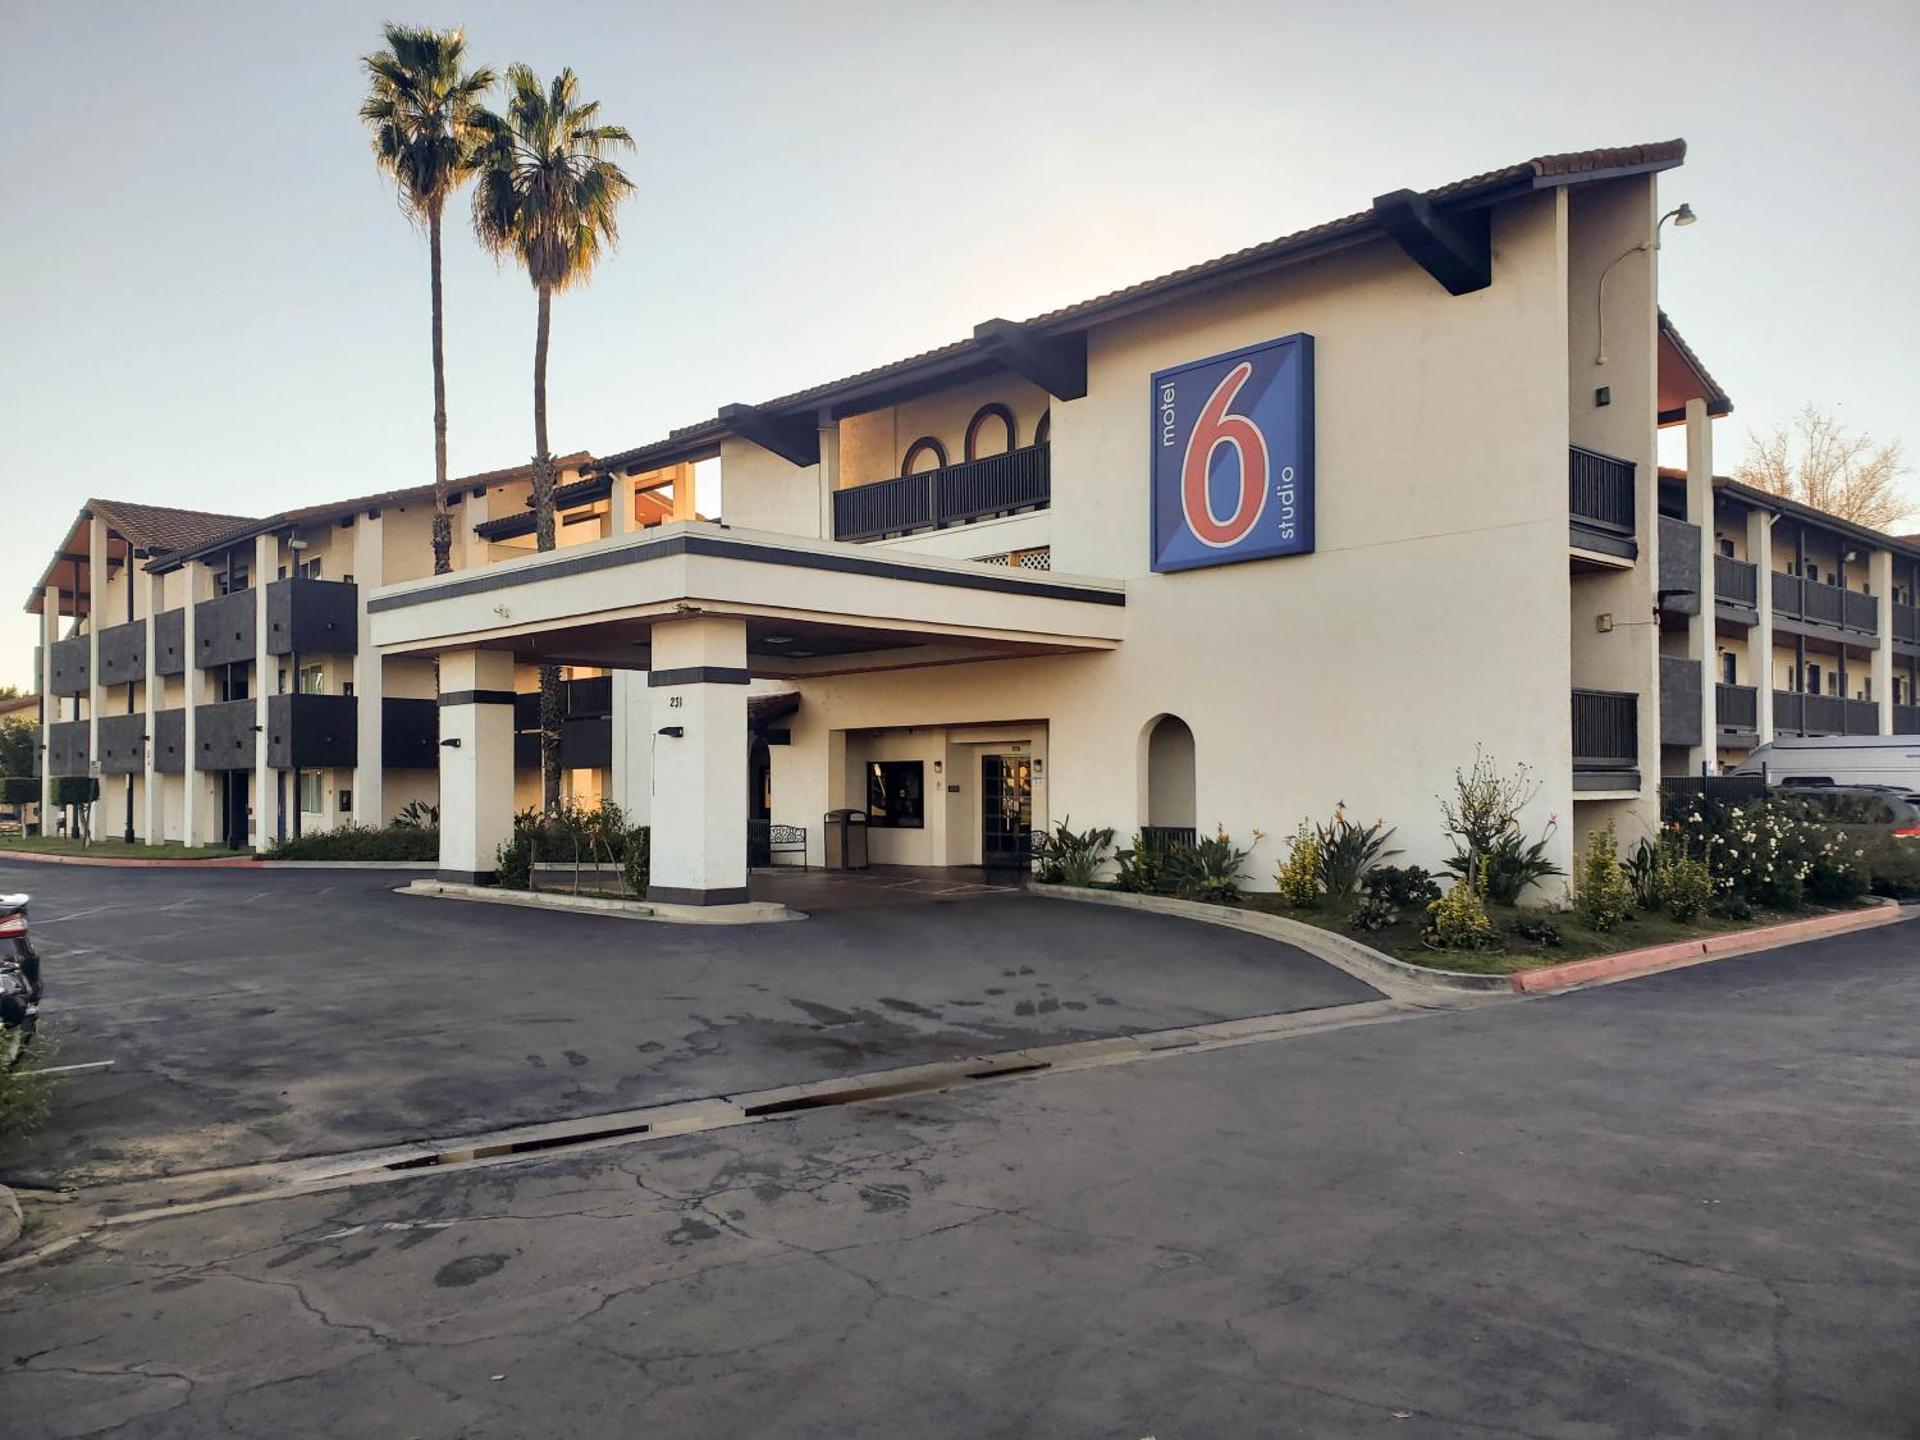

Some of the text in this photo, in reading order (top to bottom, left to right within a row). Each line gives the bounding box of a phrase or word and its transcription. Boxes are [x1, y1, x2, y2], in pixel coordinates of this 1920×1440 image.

[1160, 382, 1175, 447] motel
[1181, 361, 1270, 548] 6
[1277, 466, 1294, 540] studio
